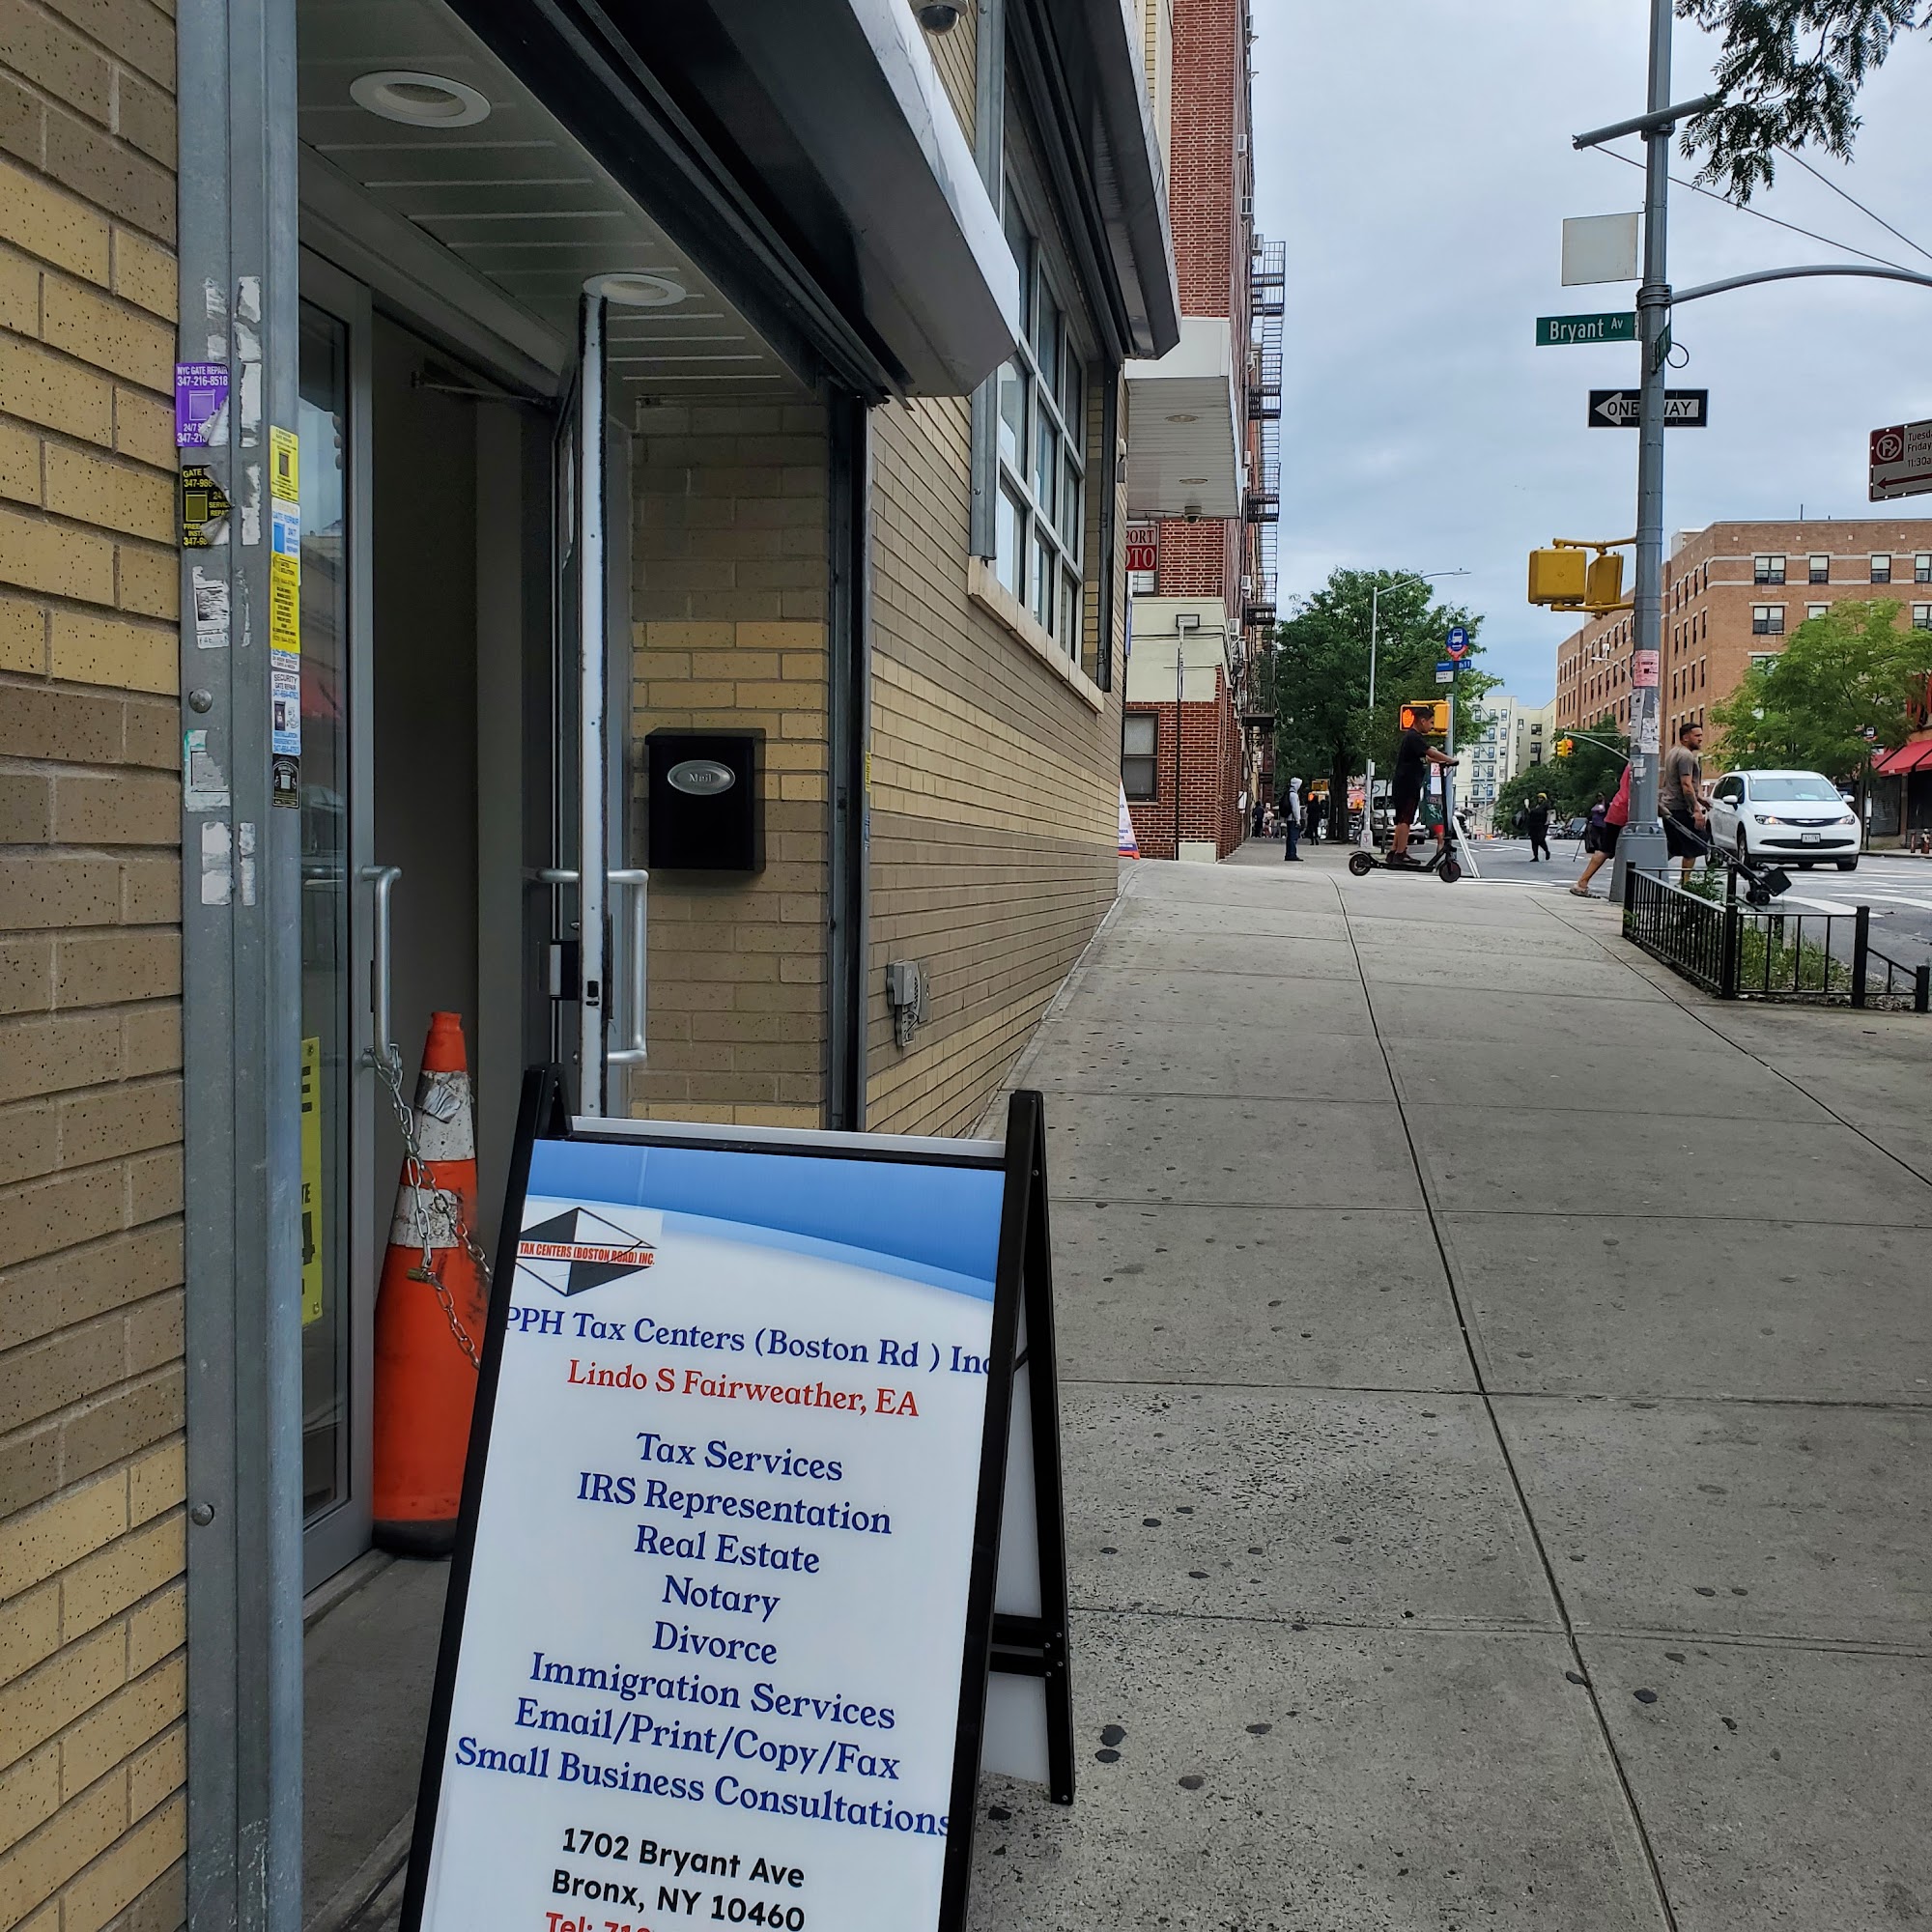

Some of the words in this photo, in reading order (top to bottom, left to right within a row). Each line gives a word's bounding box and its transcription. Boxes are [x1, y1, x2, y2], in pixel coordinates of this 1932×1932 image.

[1549, 319, 1604, 343] Bryant
[1610, 317, 1624, 329] Av
[177, 366, 190, 375] NYC
[191, 366, 206, 375] GATE
[207, 366, 228, 375] REPAIR
[177, 376, 228, 386] 347-216-8518
[184, 423, 196, 432] 24/7
[1607, 401, 1640, 416] ONE
[1908, 430, 1932, 441] Tuesd
[1908, 442, 1932, 453] Friday
[183, 469, 202, 478] GATE
[274, 673, 298, 684] SECURITY
[689, 773, 712, 782] Mail
[520, 1241, 534, 1255] TAX
[536, 1243, 572, 1258] CENTERS
[574, 1246, 610, 1261] (BOSTON
[639, 1252, 655, 1265] INC.
[573, 1312, 626, 1341] Tax
[635, 1319, 744, 1351] Centers
[755, 1327, 868, 1363] (Boston
[877, 1339, 918, 1367] Rd
[567, 1360, 647, 1390] Lindo
[656, 1368, 675, 1393] S
[682, 1371, 867, 1416] Fairweather,
[875, 1388, 919, 1417] EA
[637, 1433, 696, 1465] Tax
[704, 1440, 842, 1482] Services
[577, 1472, 636, 1505] IRS
[643, 1479, 892, 1535] Representation
[635, 1524, 706, 1560] Real
[715, 1534, 820, 1574] Estate
[662, 1575, 781, 1623] Notary
[652, 1621, 777, 1664] Divorce
[530, 1652, 740, 1709] Immigration
[751, 1683, 895, 1730] Services
[515, 1697, 900, 1780] Email/Print/Copy/Fax
[456, 1737, 550, 1778] Small
[557, 1751, 704, 1802] Business
[715, 1776, 949, 1836] Consultations
[563, 1828, 629, 1861] 1702
[639, 1839, 740, 1879] Bryant
[749, 1858, 805, 1889] Ave
[553, 1869, 644, 1914] Bronx,
[658, 1886, 701, 1916] NY
[711, 1895, 804, 1932] 10460
